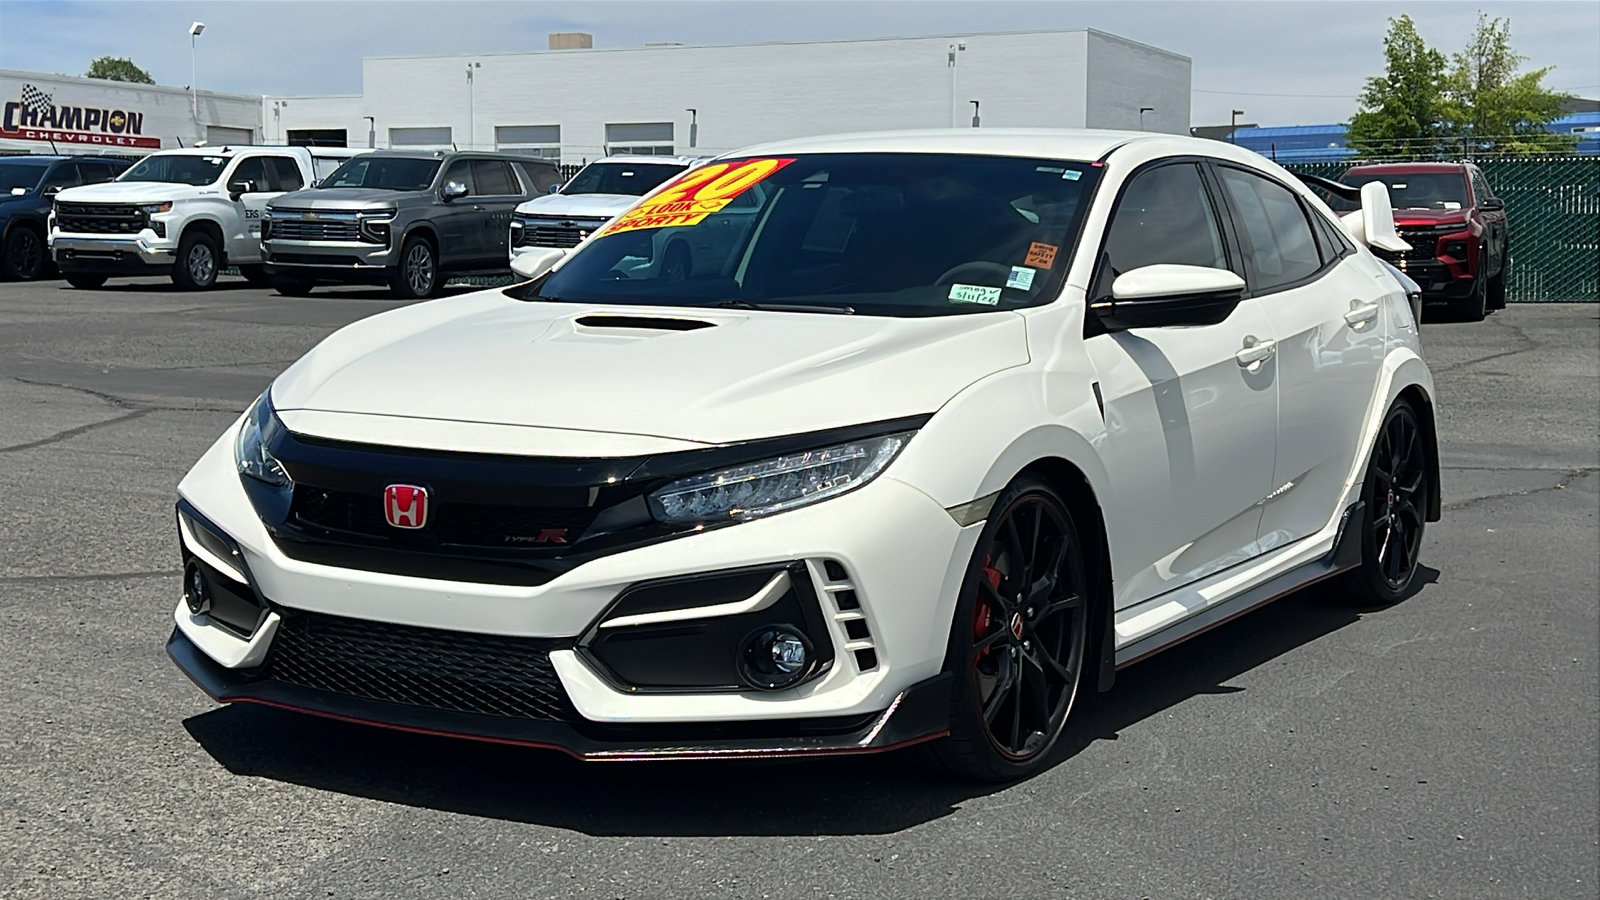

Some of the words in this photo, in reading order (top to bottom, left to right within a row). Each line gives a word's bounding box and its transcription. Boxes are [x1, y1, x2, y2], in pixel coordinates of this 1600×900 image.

[3, 102, 143, 135] CHAMPION
[26, 131, 137, 145] CHEVROLET
[642, 159, 778, 207] 20
[645, 201, 697, 215] LOOK
[604, 213, 702, 235] SPORTY
[504, 535, 537, 543] TYPE
[536, 528, 569, 543] R
